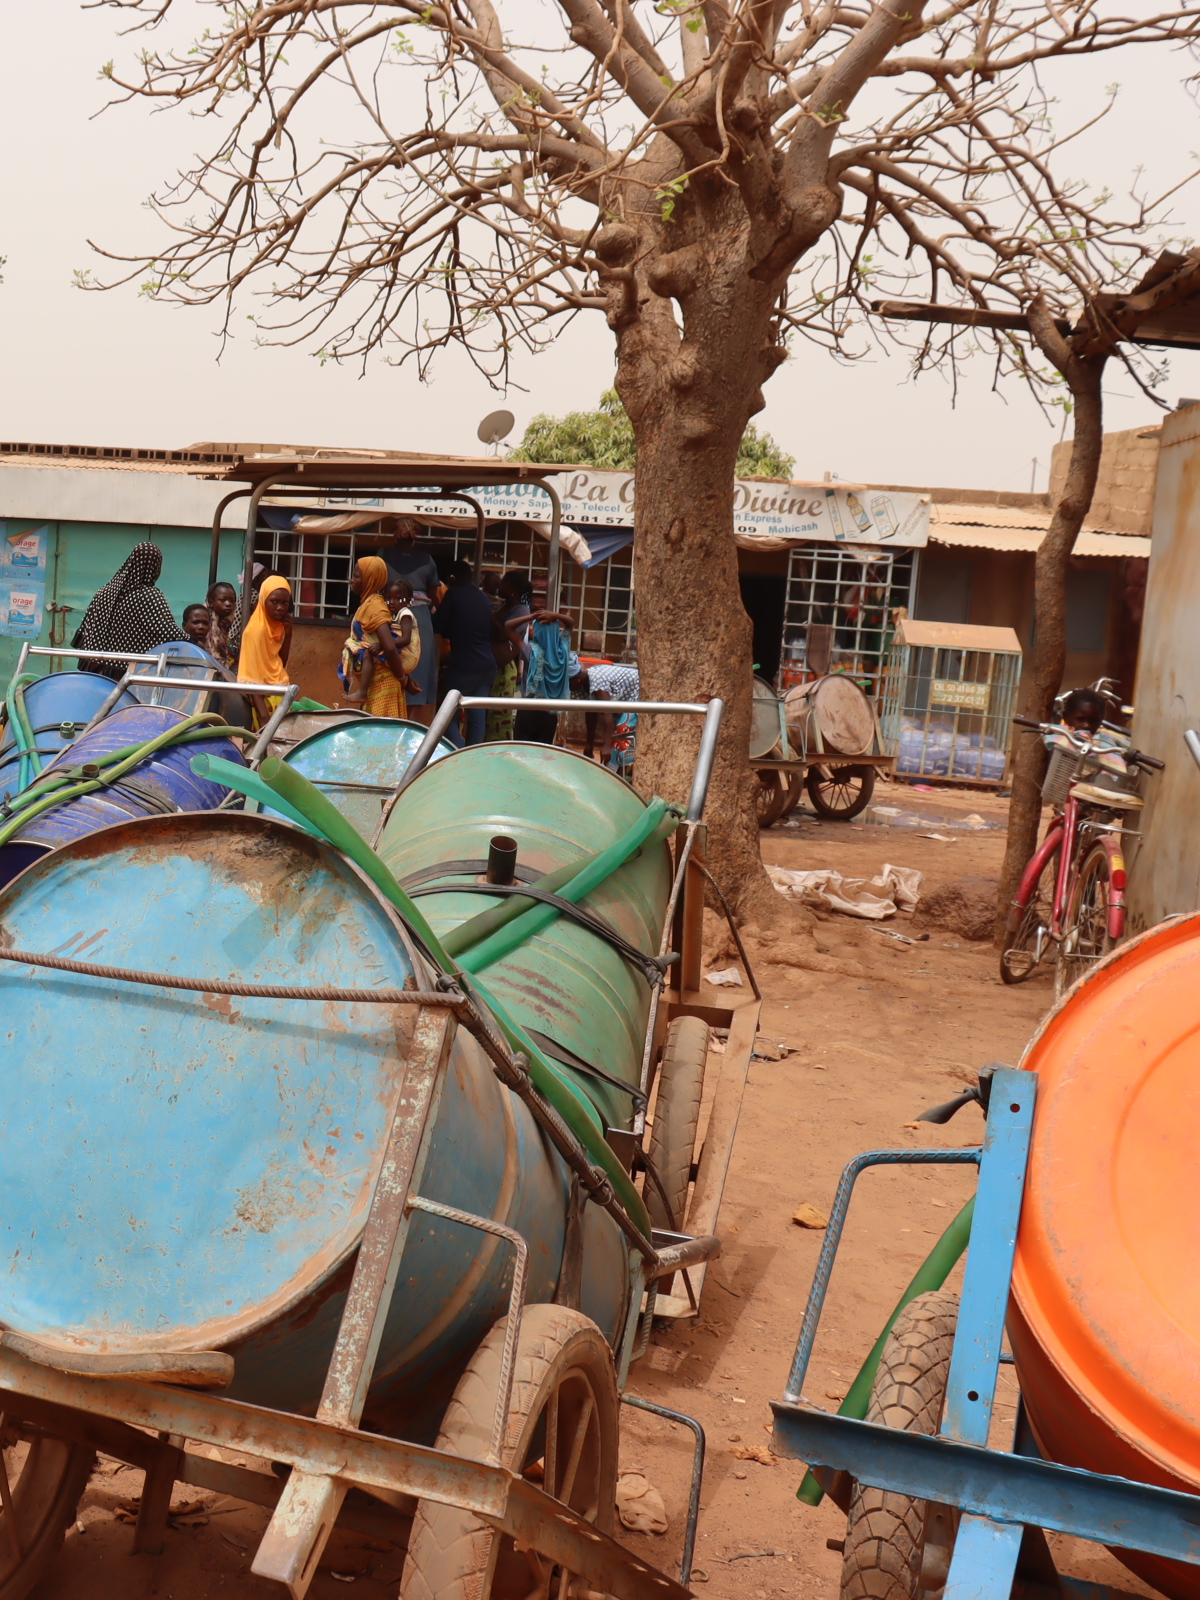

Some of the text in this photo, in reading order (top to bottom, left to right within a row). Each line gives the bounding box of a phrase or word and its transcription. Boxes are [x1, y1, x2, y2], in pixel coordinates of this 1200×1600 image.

[563, 473, 609, 502] La
[483, 497, 518, 508] Money
[581, 502, 621, 512] Telecel
[733, 484, 824, 517] Divine
[413, 505, 443, 514] Tél:
[449, 507, 468, 515] 78
[522, 511, 542, 519] 12
[605, 517, 625, 525] 57
[744, 513, 782, 524] Express
[737, 525, 757, 533] 09
[768, 522, 819, 534] Mobicash
[12, 597, 34, 606] orage
